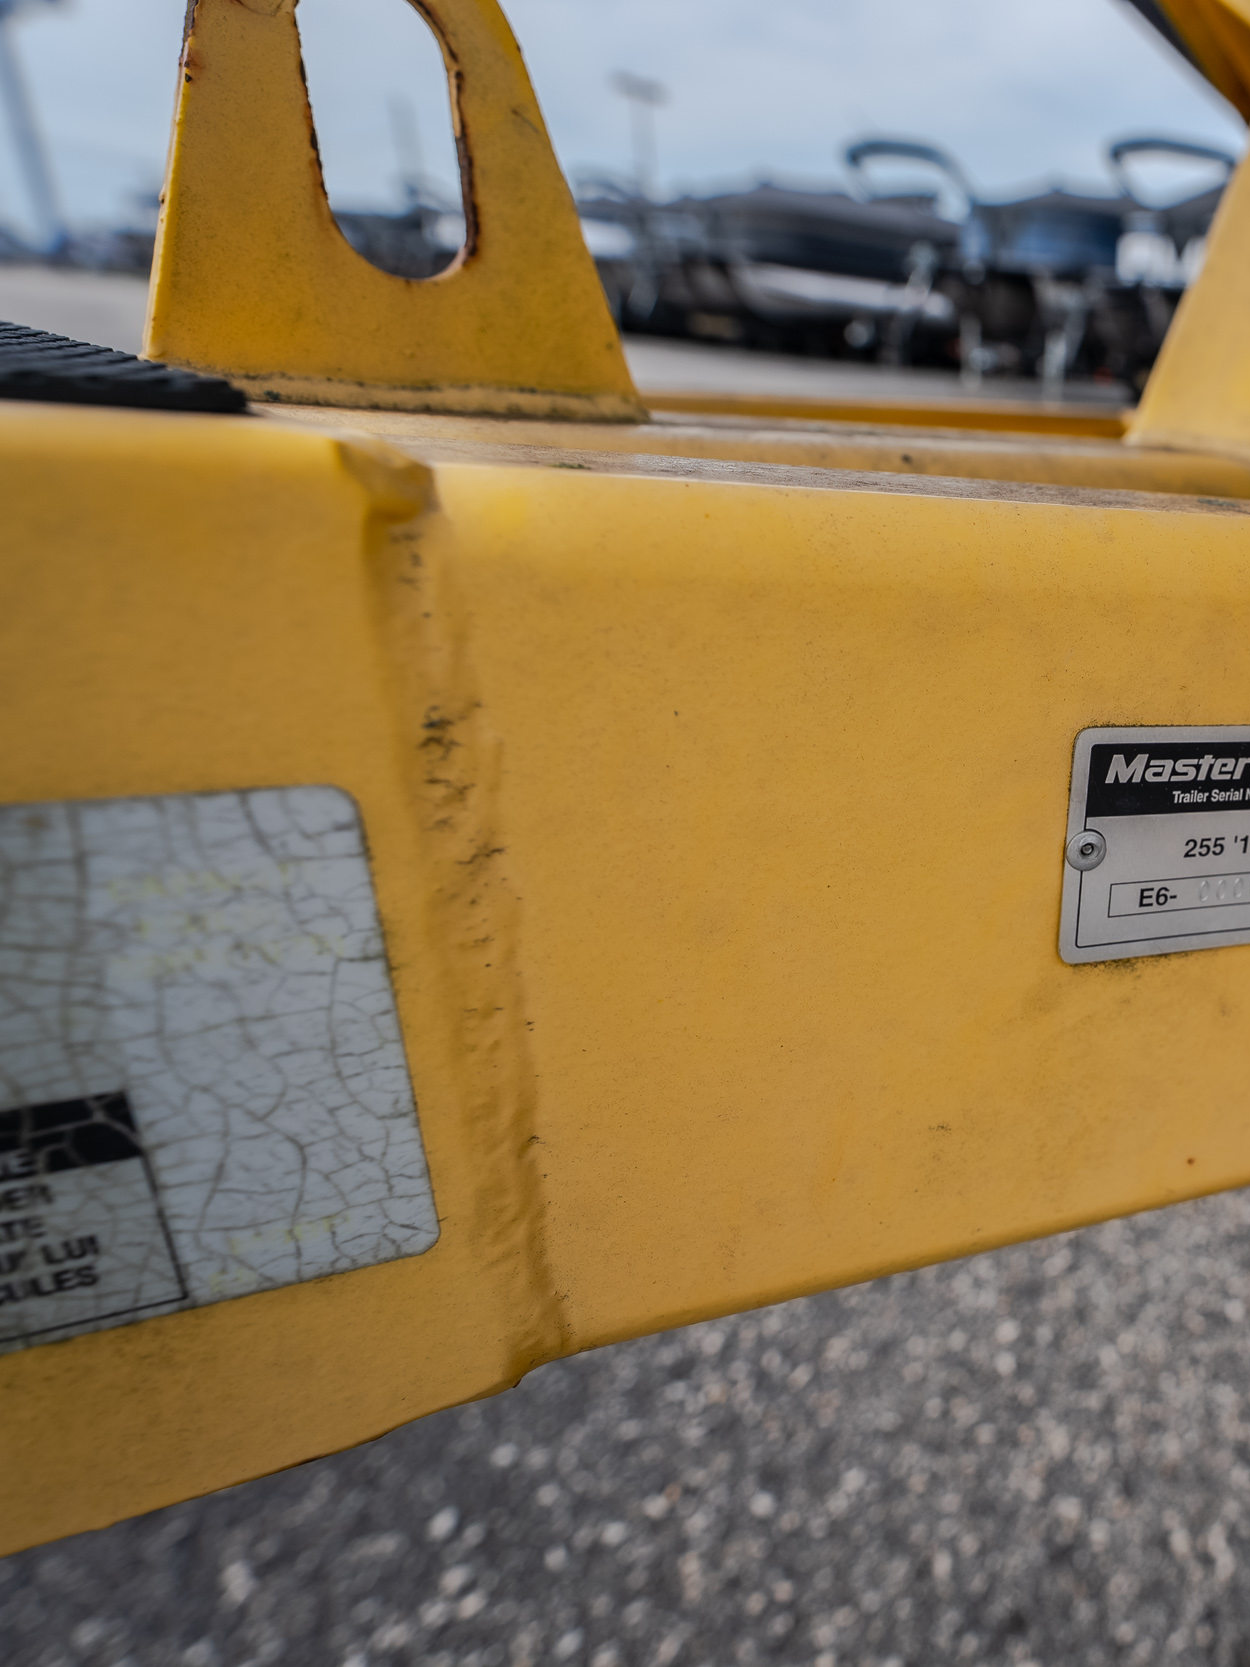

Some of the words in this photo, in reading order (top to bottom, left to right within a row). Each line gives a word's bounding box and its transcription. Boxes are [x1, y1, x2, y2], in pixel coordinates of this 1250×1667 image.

[1172, 789, 1209, 804] Trailer
[1210, 787, 1243, 802] Serial
[1183, 837, 1225, 858] 255
[1138, 886, 1178, 908] E6-
